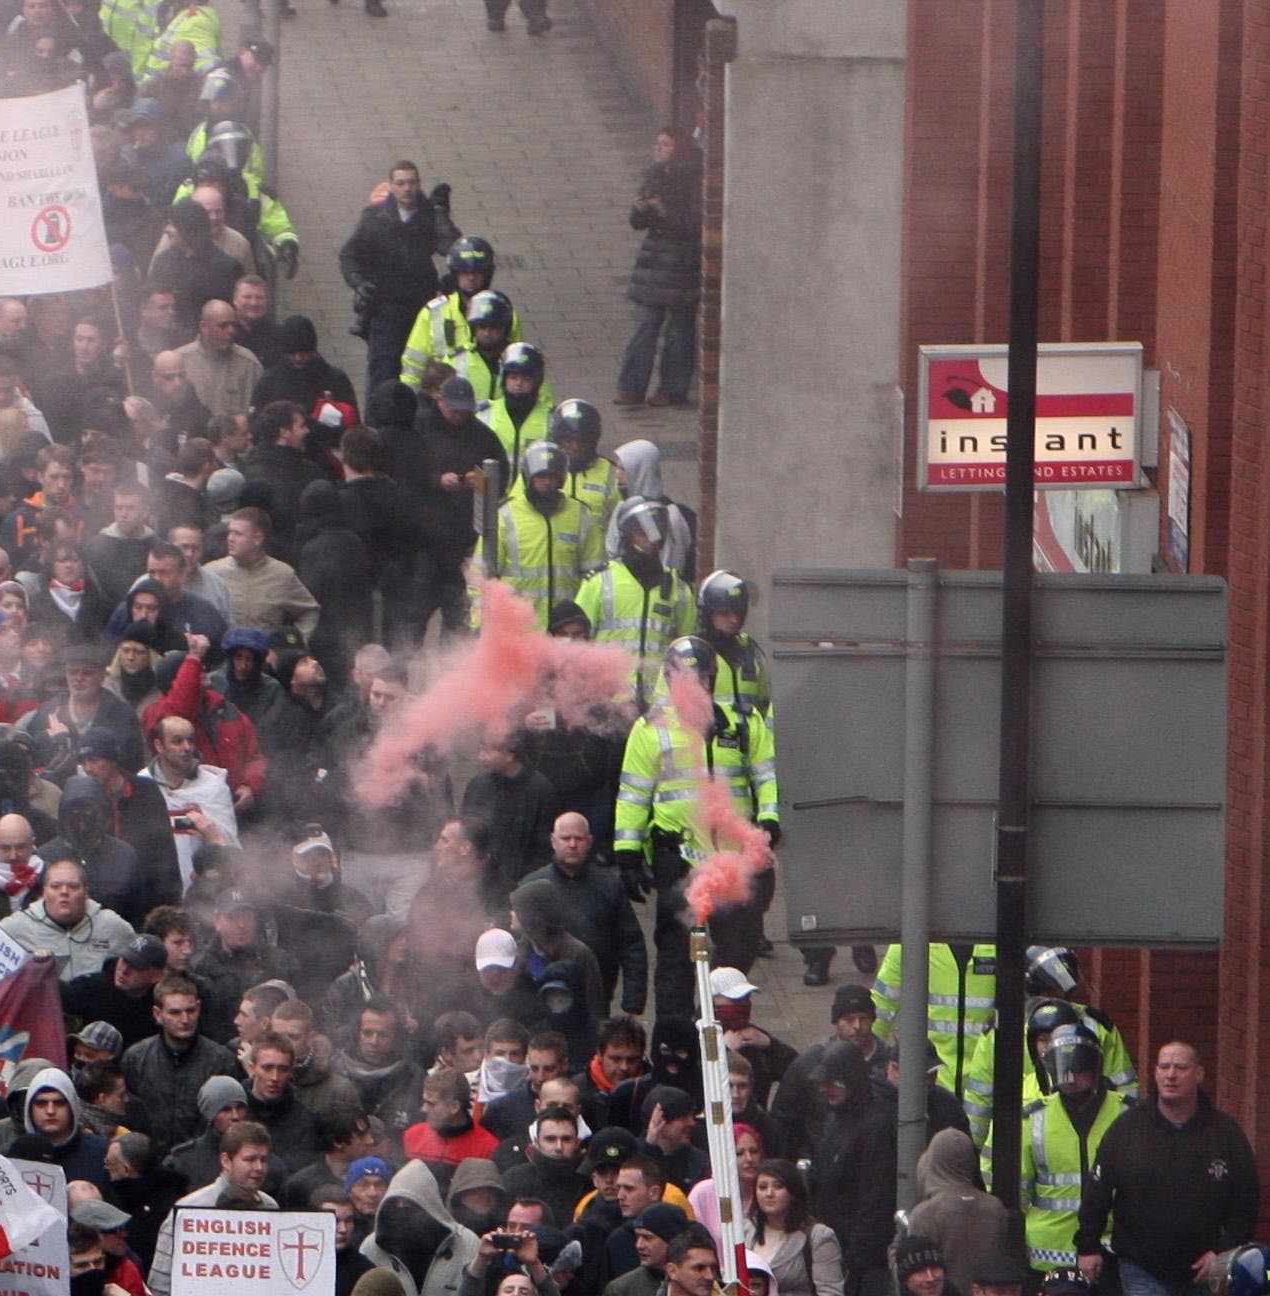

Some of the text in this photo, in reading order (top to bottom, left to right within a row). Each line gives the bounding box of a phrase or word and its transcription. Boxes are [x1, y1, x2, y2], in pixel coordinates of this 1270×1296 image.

[940, 427, 1123, 453] insant
[940, 465, 1123, 480] LETTING ND ESTATES
[183, 1218, 271, 1236] ENGLISH
[182, 1240, 271, 1258] DEFENCE
[181, 1262, 271, 1279] LEAGUE
